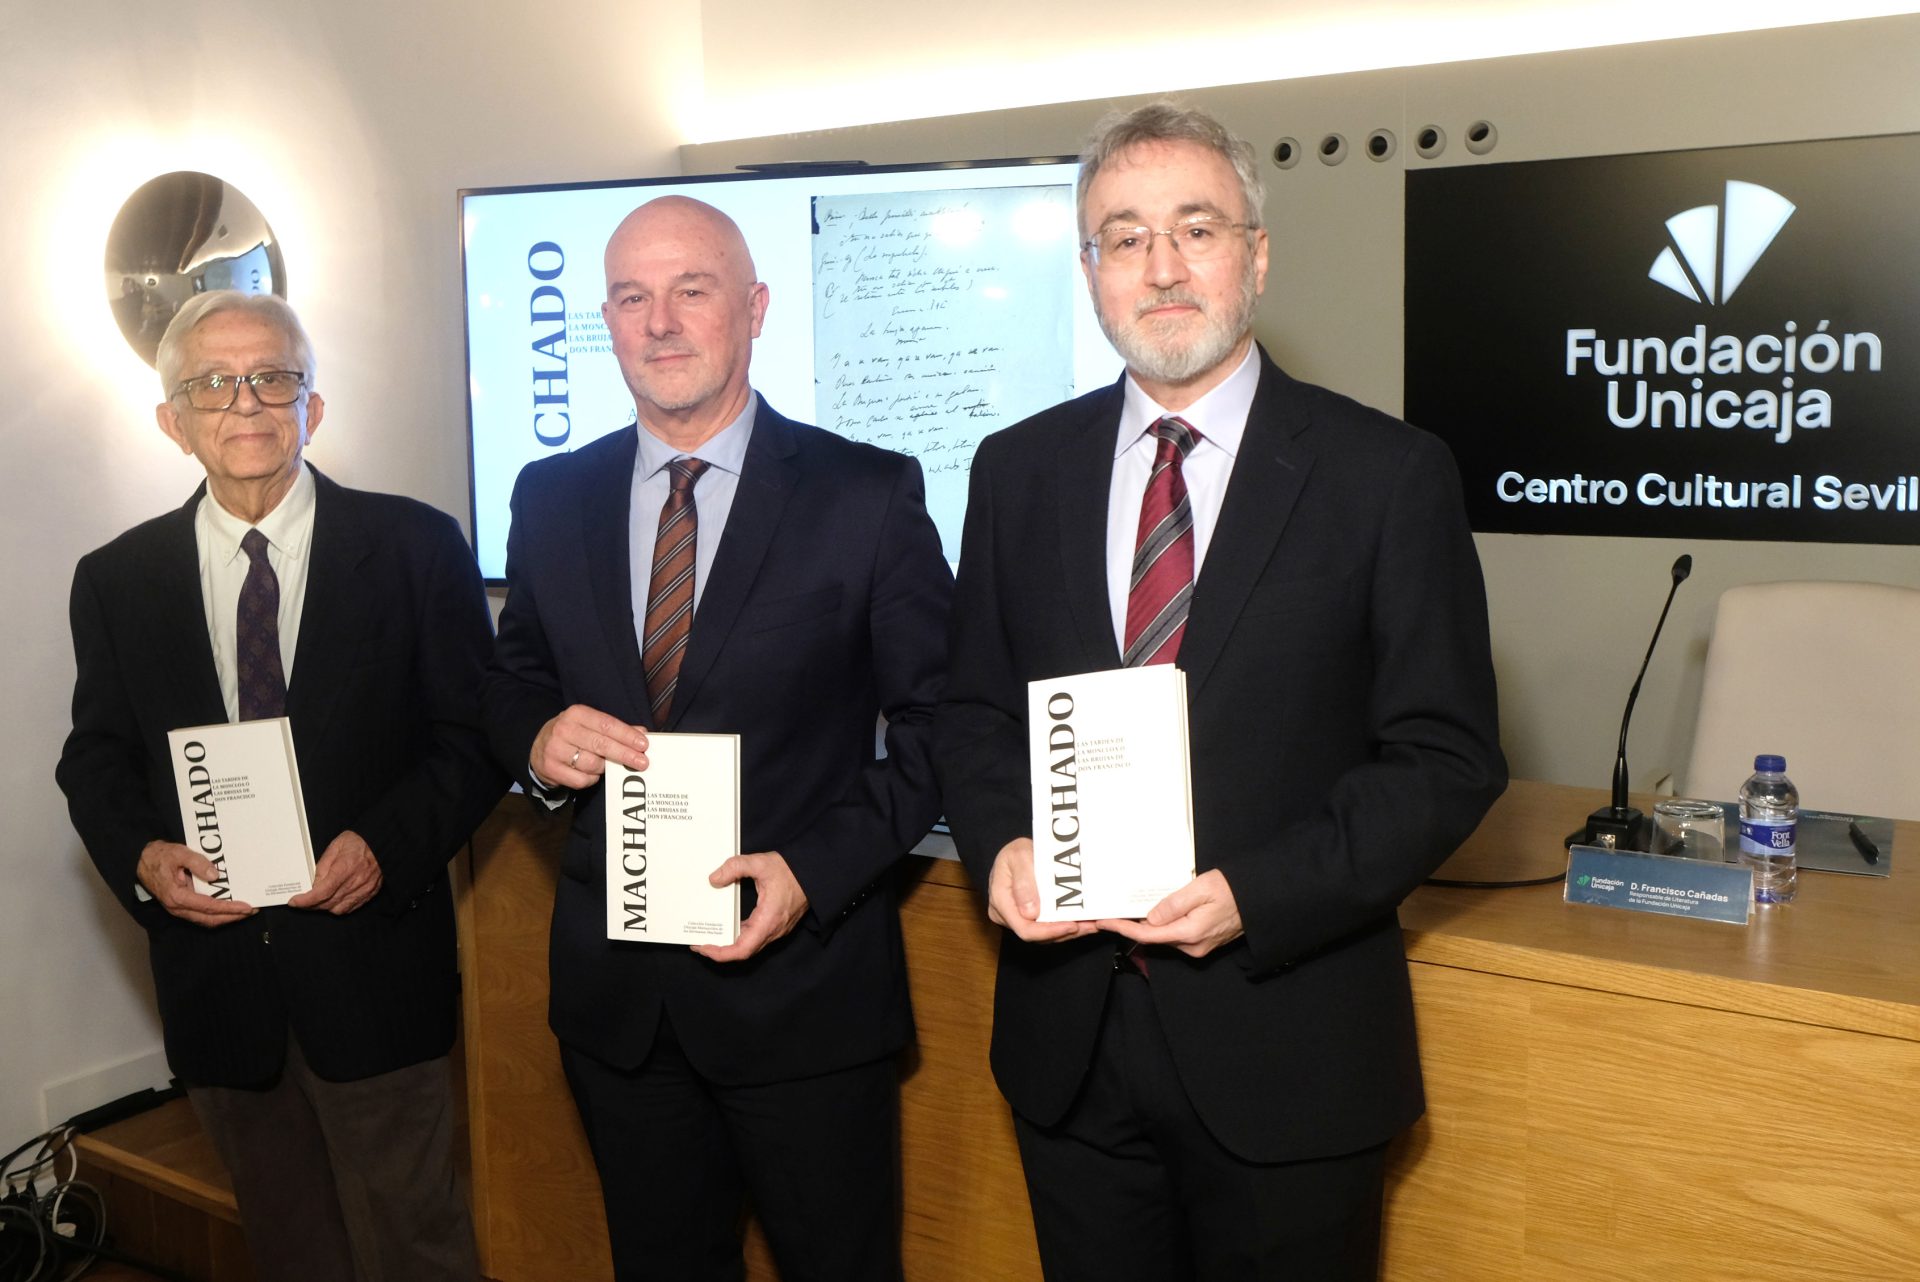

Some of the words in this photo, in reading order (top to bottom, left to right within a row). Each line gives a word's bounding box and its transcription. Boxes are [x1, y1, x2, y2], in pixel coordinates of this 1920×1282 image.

[568, 312, 584, 320] LAS
[586, 311, 602, 319] TAR
[568, 323, 579, 331] LA
[581, 323, 608, 331] MONC
[527, 241, 571, 453] CHADO
[590, 345, 612, 353] FRAN
[1566, 319, 1882, 376] Fundación
[1607, 376, 1832, 444] Unicaja
[1496, 471, 1628, 503] Centro
[1637, 474, 1802, 508] Cultural
[1813, 475, 1919, 511] Sevil
[1047, 692, 1084, 910] MACHADO
[183, 741, 232, 901] MACHADO
[1771, 831, 1790, 840] Font
[1771, 838, 1790, 848] Vella
[1591, 876, 1624, 887] Fundación
[1591, 881, 1615, 892] Unicaja
[1629, 890, 1664, 901] Responsable
[1672, 896, 1699, 905] Literatura
[1630, 882, 1640, 891] D.
[1641, 883, 1686, 897] Francisco
[1687, 888, 1729, 903] Cañadas
[1641, 898, 1670, 908] Fundación
[1670, 901, 1691, 911] Unicaja
